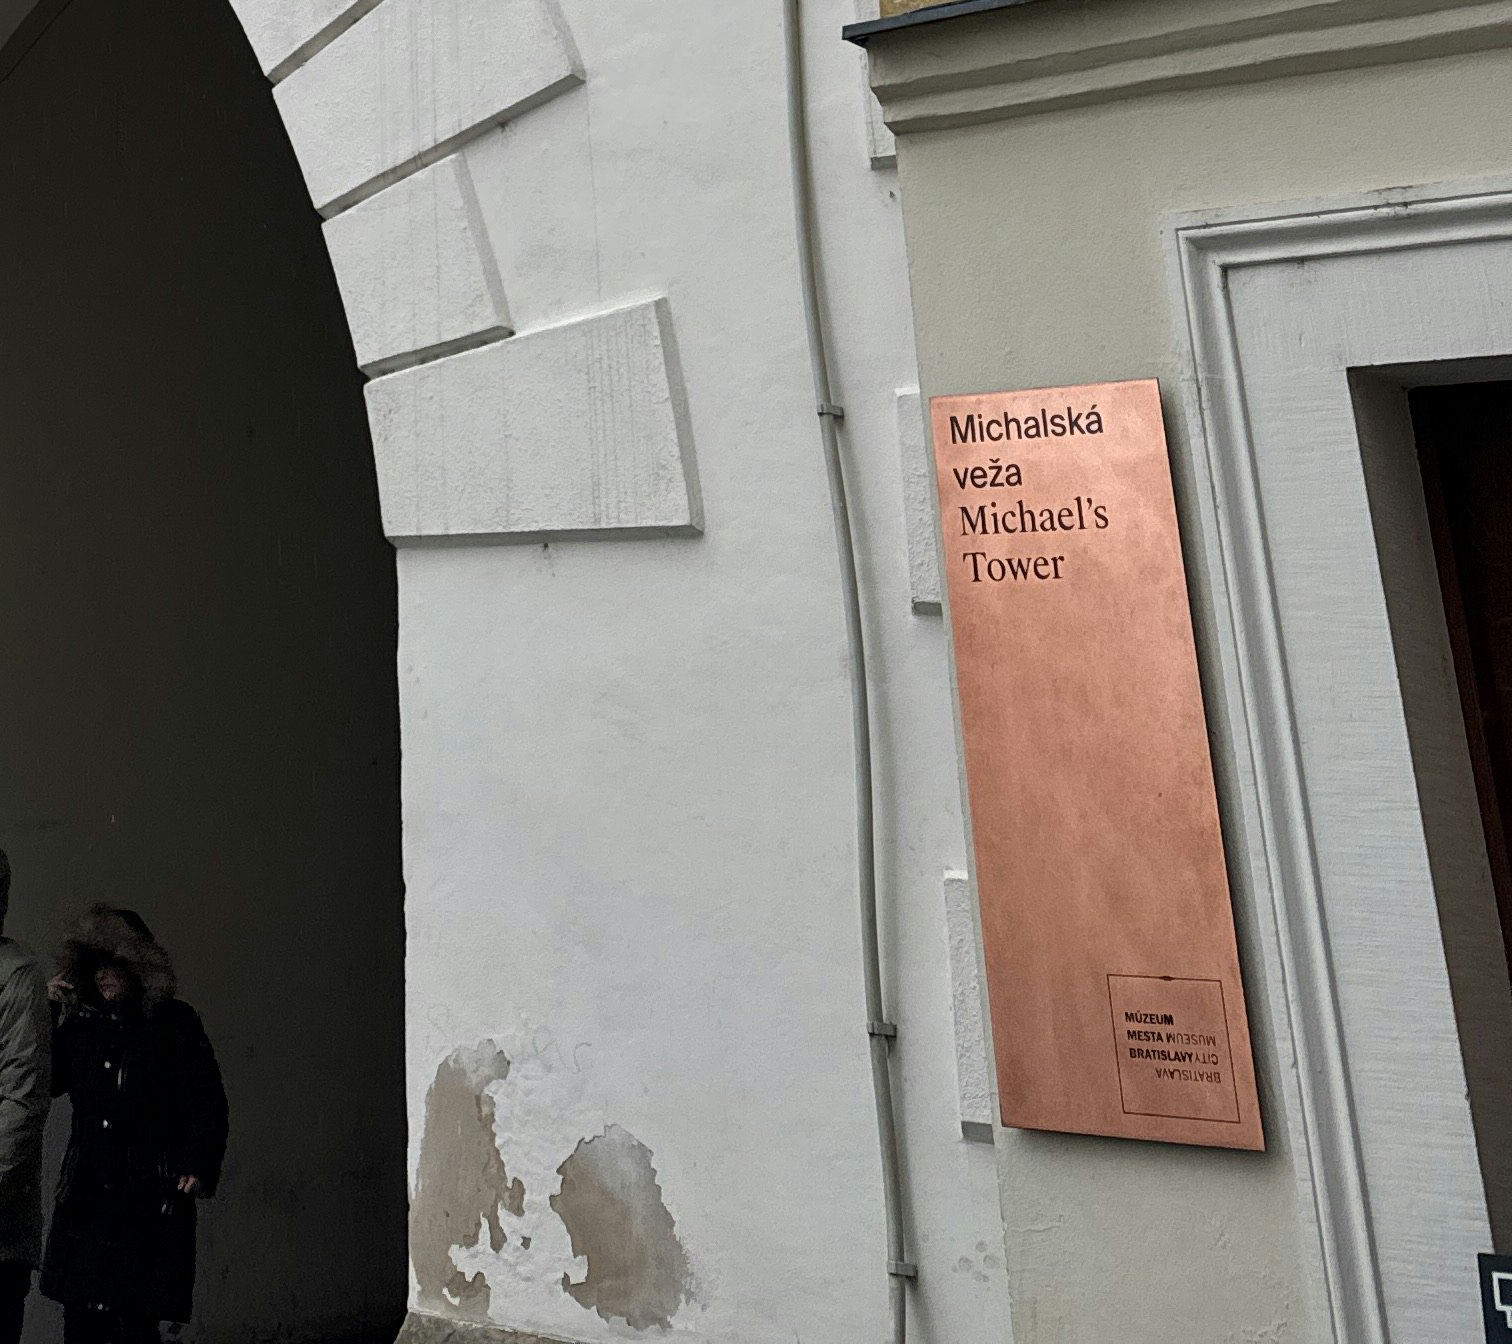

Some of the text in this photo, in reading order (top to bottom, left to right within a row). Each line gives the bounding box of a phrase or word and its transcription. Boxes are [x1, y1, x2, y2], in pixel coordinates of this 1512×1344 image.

[949, 404, 1104, 444] Michalská
[953, 458, 1022, 489] veža
[959, 496, 1109, 536] Michael's
[963, 552, 1065, 582] Tower
[1125, 1010, 1174, 1026] MÚZEUM
[1127, 1030, 1164, 1043] MESTA
[1129, 1048, 1192, 1063] BRATISLAVY
